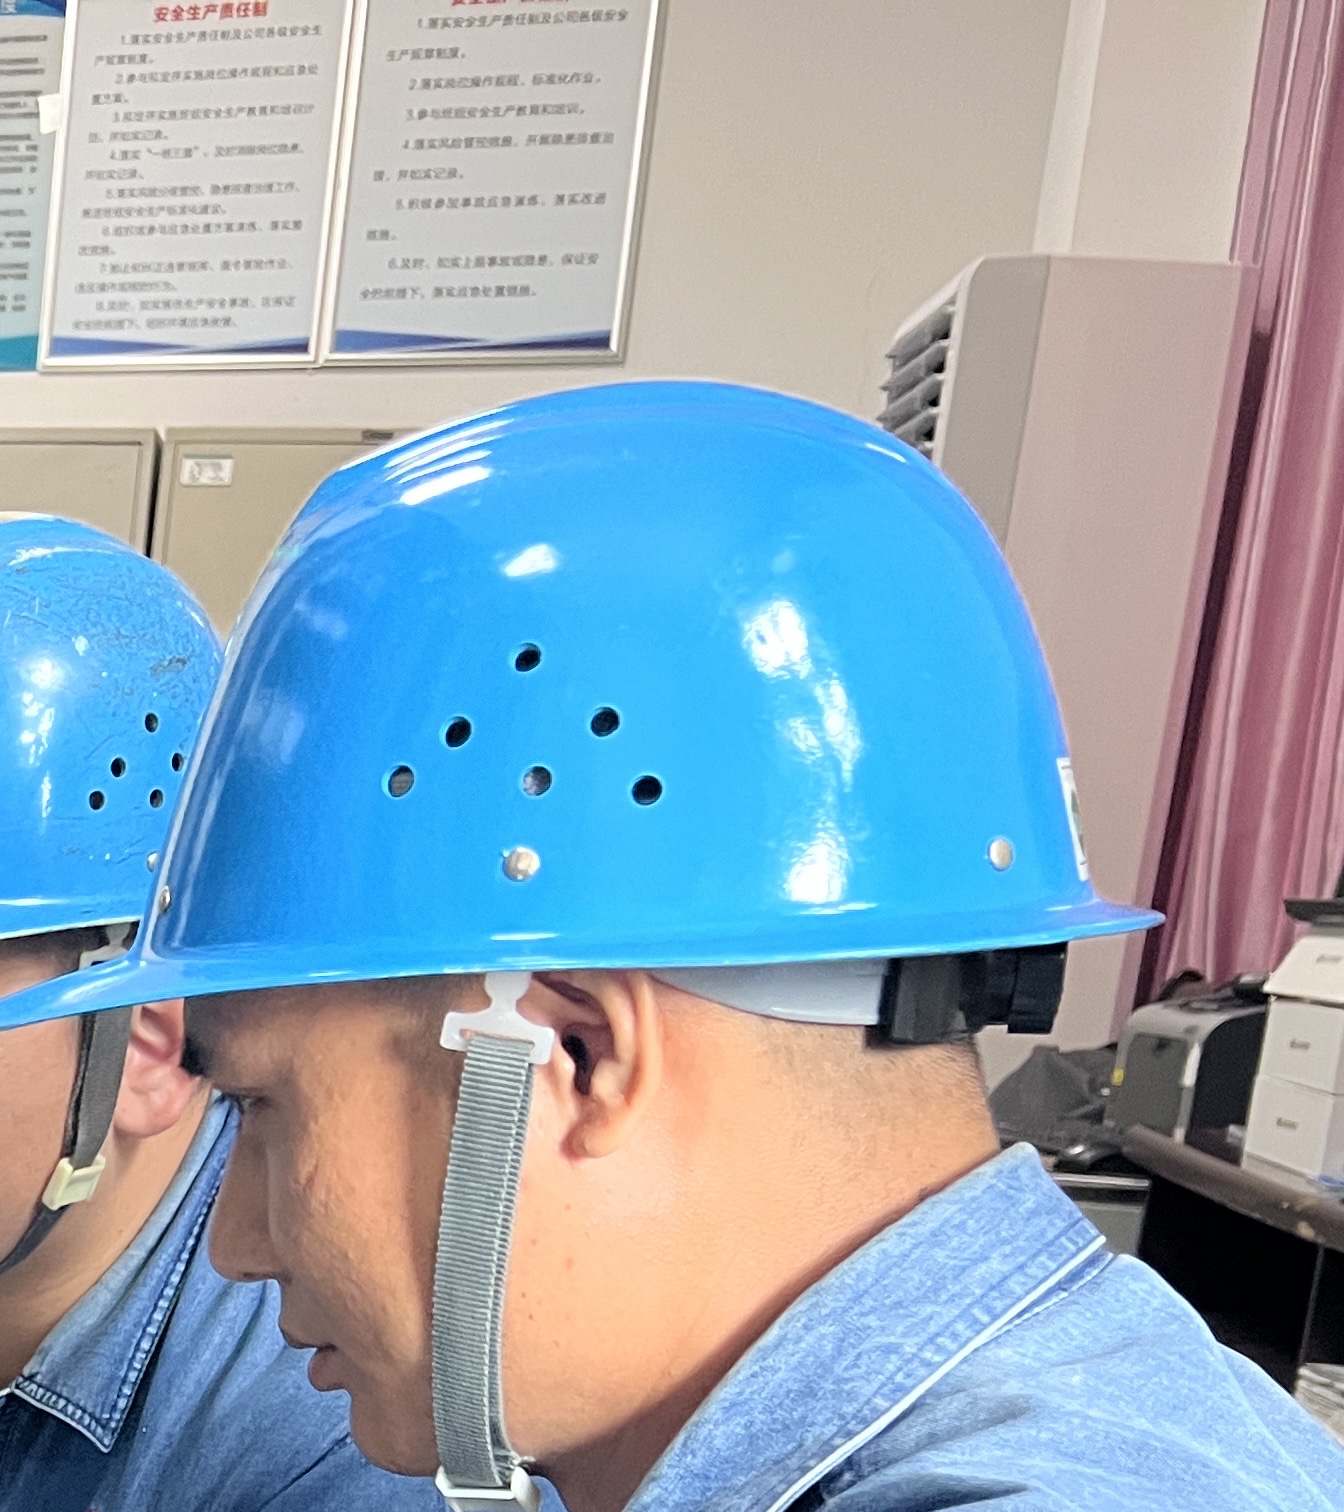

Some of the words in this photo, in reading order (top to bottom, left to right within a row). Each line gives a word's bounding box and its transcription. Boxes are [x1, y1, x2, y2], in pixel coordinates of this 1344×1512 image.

[153, 1, 269, 22] 安全生产责任制
